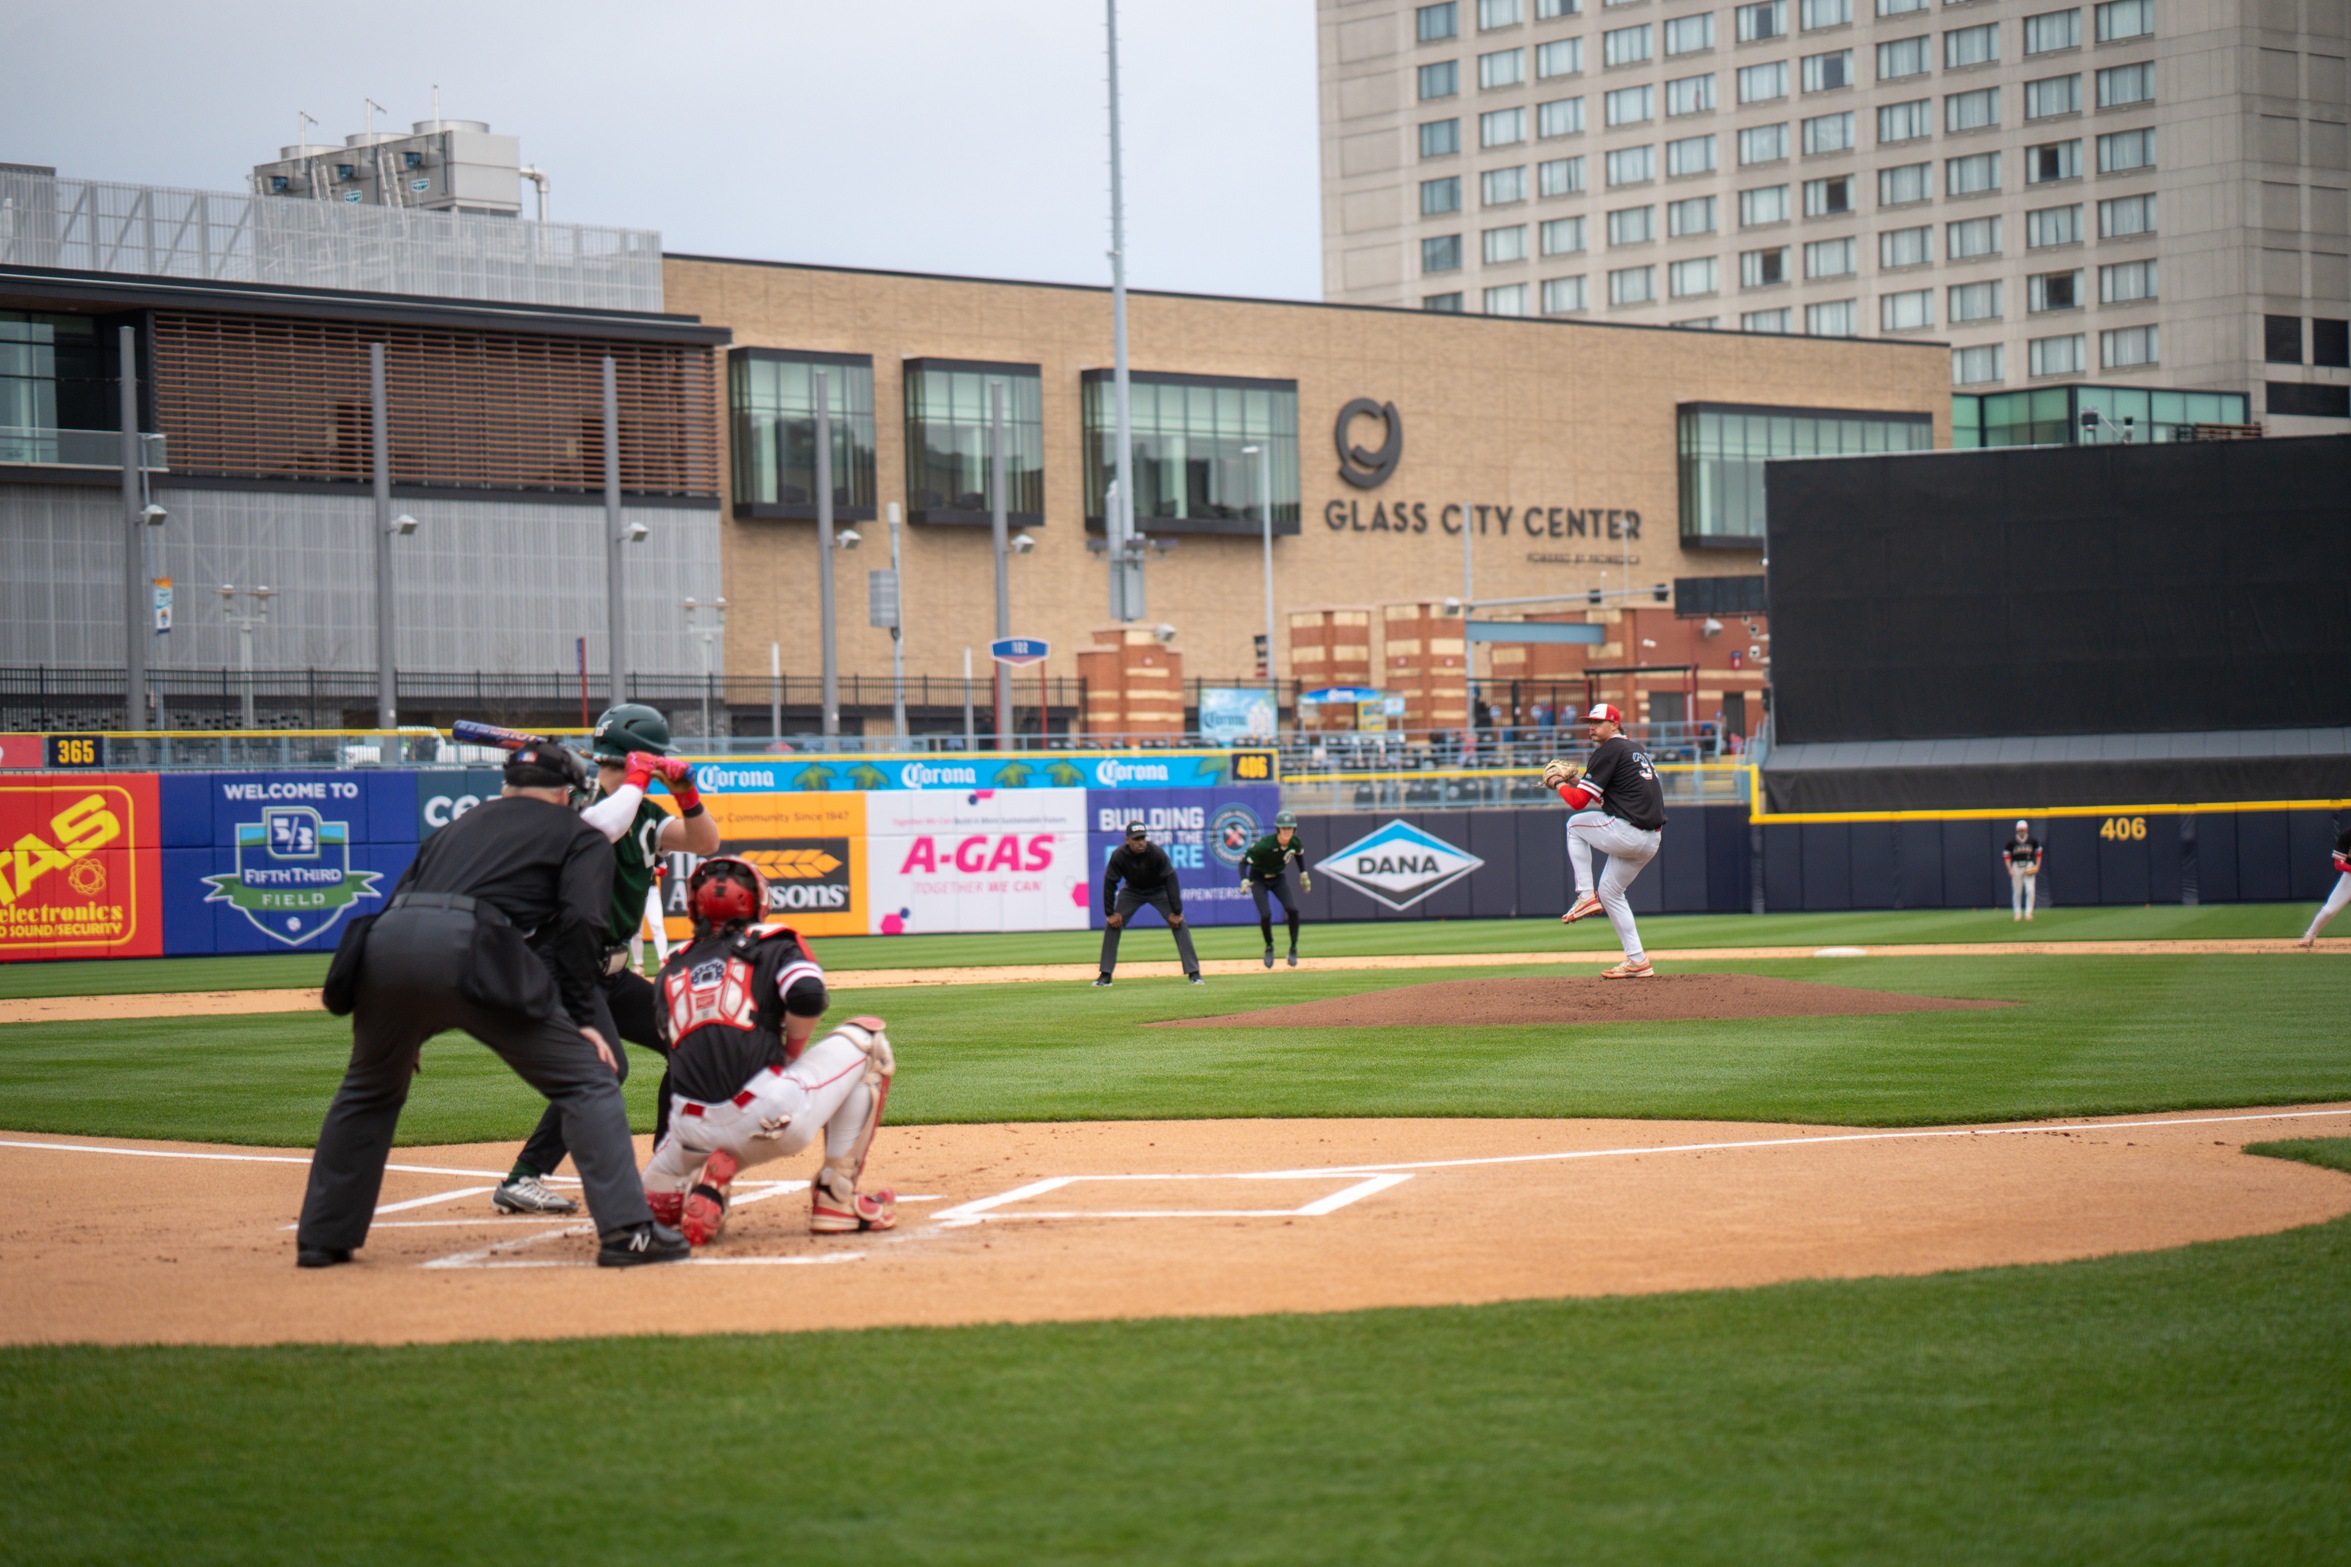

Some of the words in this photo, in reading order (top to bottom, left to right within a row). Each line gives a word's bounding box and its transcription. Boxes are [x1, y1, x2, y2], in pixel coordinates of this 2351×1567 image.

[1324, 499, 1427, 533] GLASS
[1441, 503, 1514, 536] CTY
[1523, 507, 1641, 541] CENTER
[1203, 712, 1248, 728] Corona
[58, 739, 95, 764] 365
[697, 764, 775, 794] Corona
[901, 762, 976, 789] Corona
[1096, 759, 1169, 786] Corona
[1237, 755, 1268, 779] 406
[223, 783, 327, 801] WELCOME
[330, 782, 359, 799] TO
[727, 812, 789, 825] Community
[794, 810, 822, 821] Since
[1099, 806, 1205, 832] BUILDING
[2099, 817, 2147, 841] 406
[1177, 830, 1204, 845] THE
[669, 851, 704, 880] Th
[900, 833, 1056, 875] A-GAS
[1357, 855, 1441, 875] DANA
[244, 868, 292, 885] FIFTH
[293, 867, 343, 883] THIRD
[914, 881, 984, 895] TOGETHER
[988, 880, 1009, 894] WE
[1013, 879, 1042, 893] CAN
[262, 892, 326, 907] FIELD
[667, 880, 847, 912] Asons
[0, 900, 124, 925] electronics
[10, 922, 123, 938] SOUND/SECURITY
